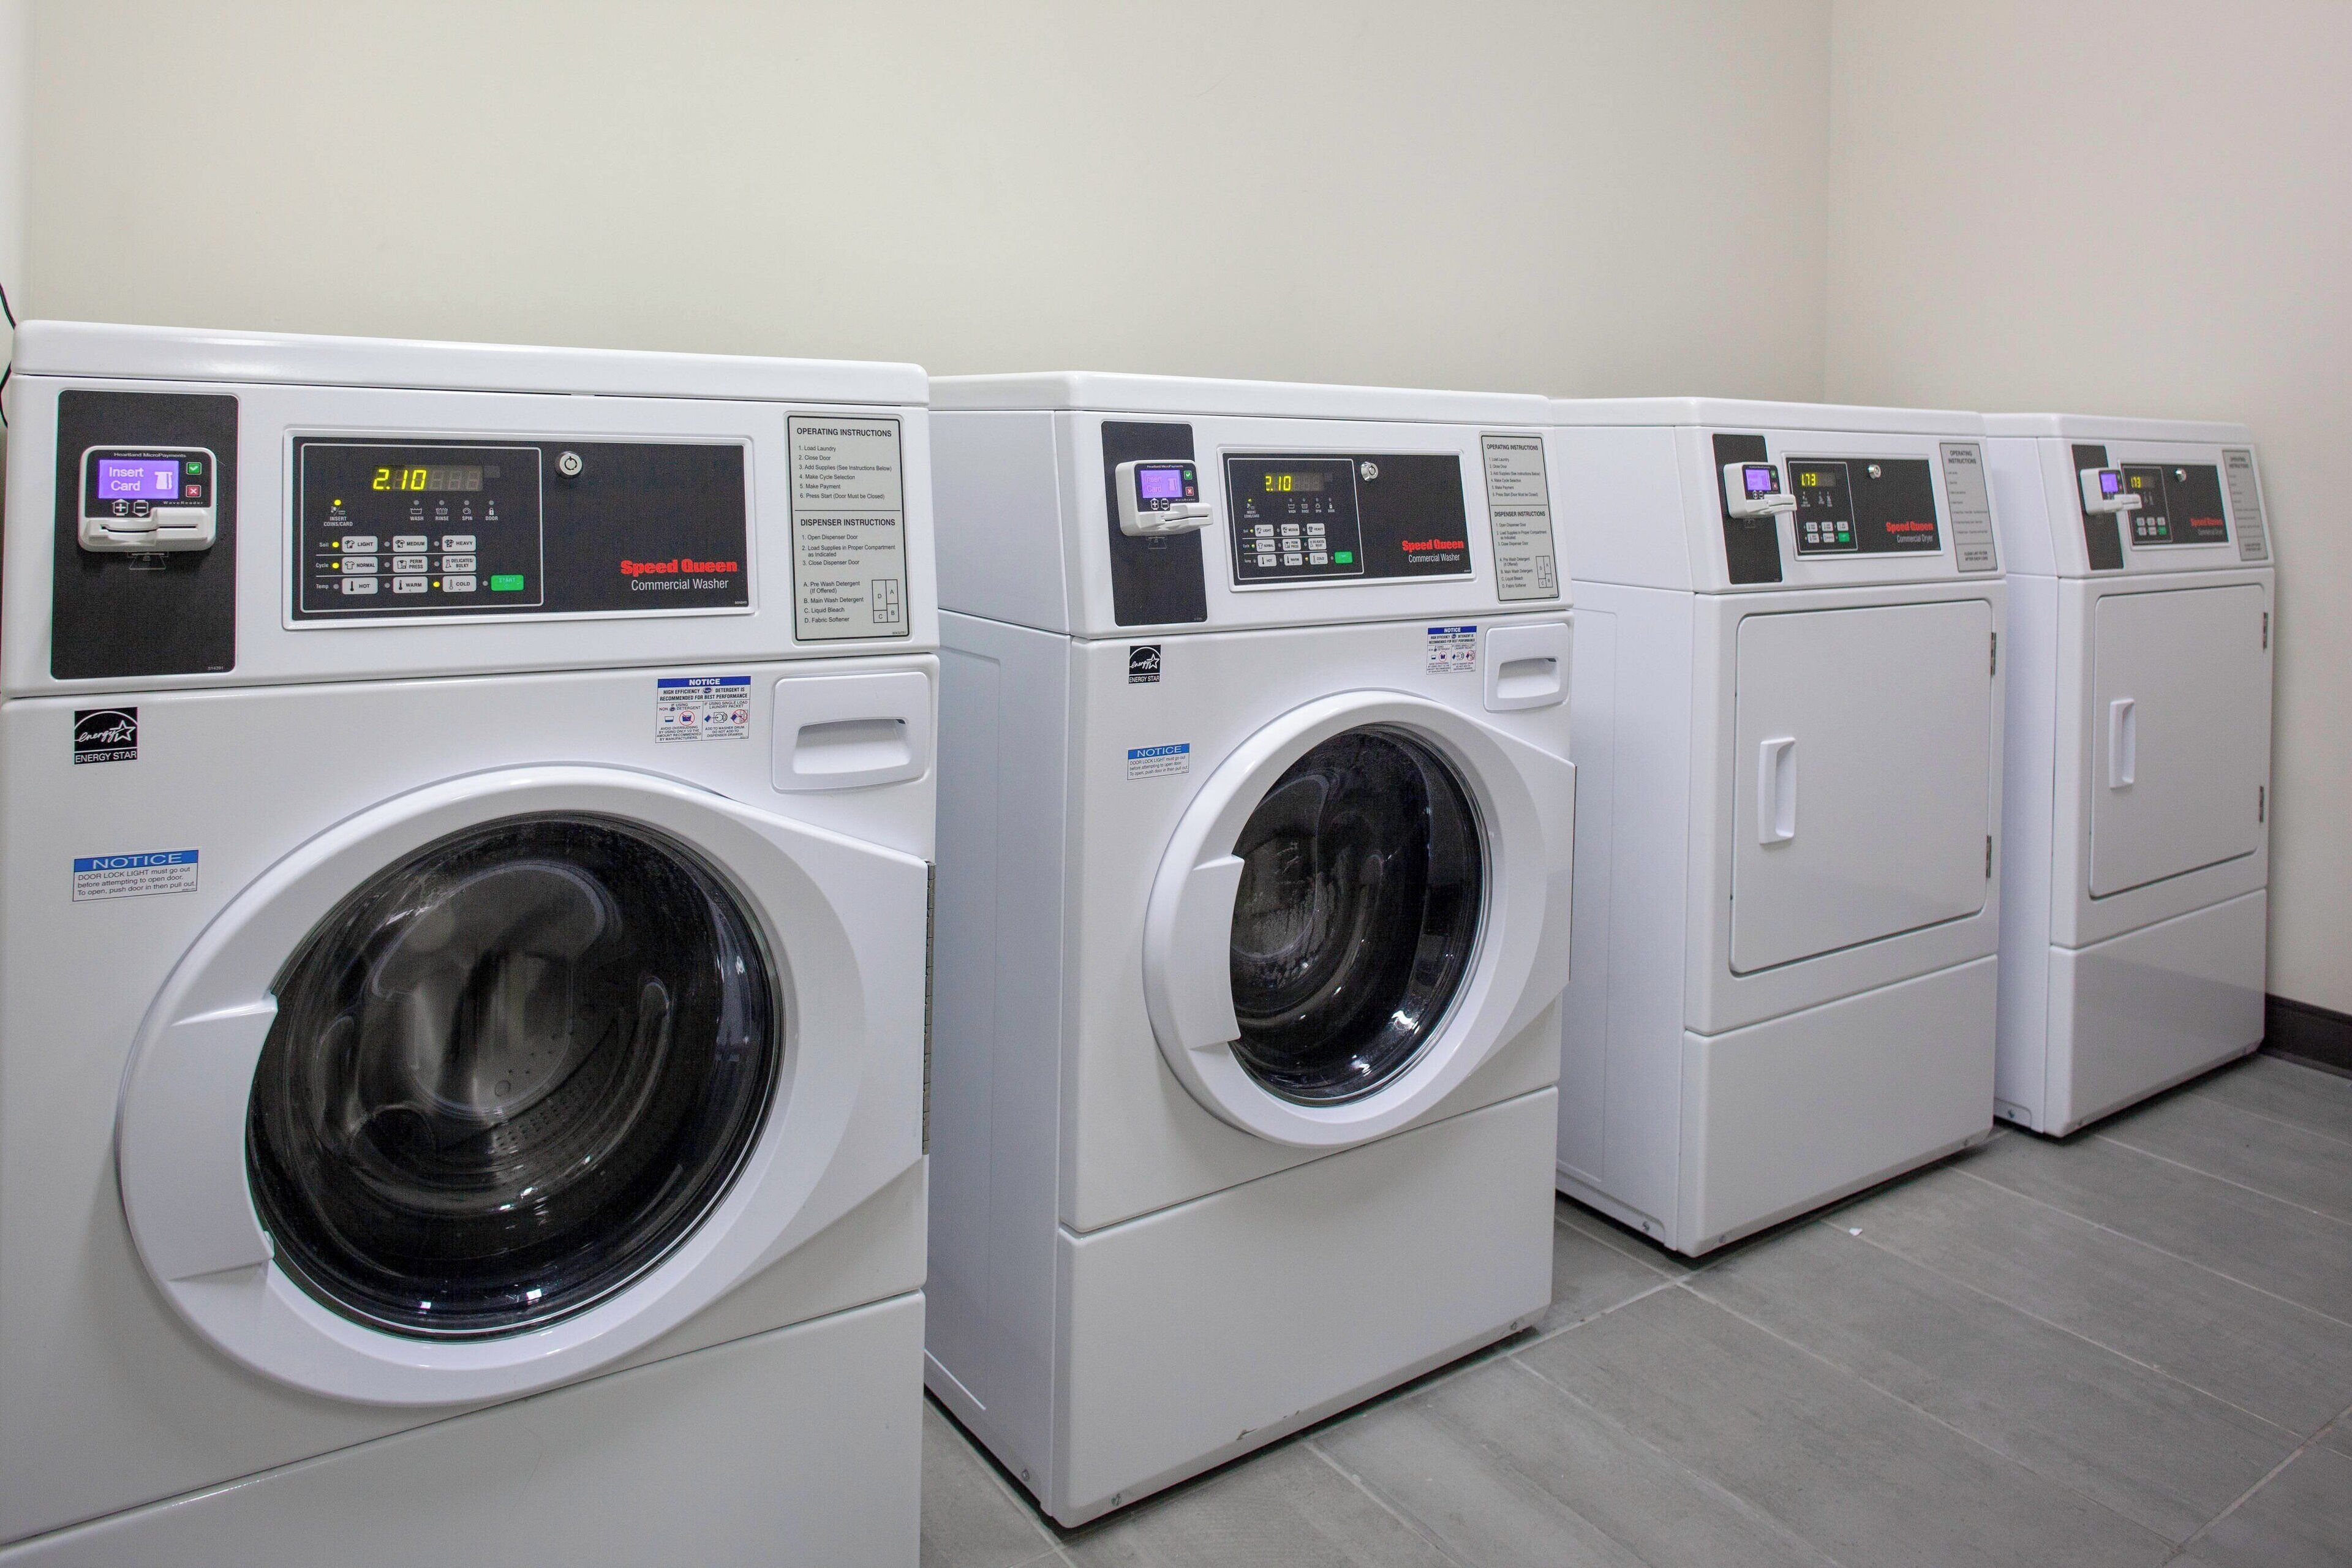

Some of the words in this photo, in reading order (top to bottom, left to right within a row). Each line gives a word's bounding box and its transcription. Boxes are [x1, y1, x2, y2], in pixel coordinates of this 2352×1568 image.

[109, 467, 144, 477] Insert
[111, 480, 140, 491] Card
[373, 469, 426, 490] 2.10
[1265, 475, 1291, 491] 2.10
[1886, 521, 1910, 534] Speed
[1910, 522, 1933, 531] Queen
[1402, 540, 1433, 552] Speed
[1433, 539, 1464, 549] Queen
[620, 559, 678, 577] Speed
[681, 558, 737, 573] Queen
[631, 579, 690, 590] Commercial
[693, 578, 729, 589] Washer
[75, 753, 111, 763] ENERGY
[113, 751, 136, 760] STAR
[1137, 745, 1182, 757] NOTICE
[93, 853, 183, 869] NOTICE
